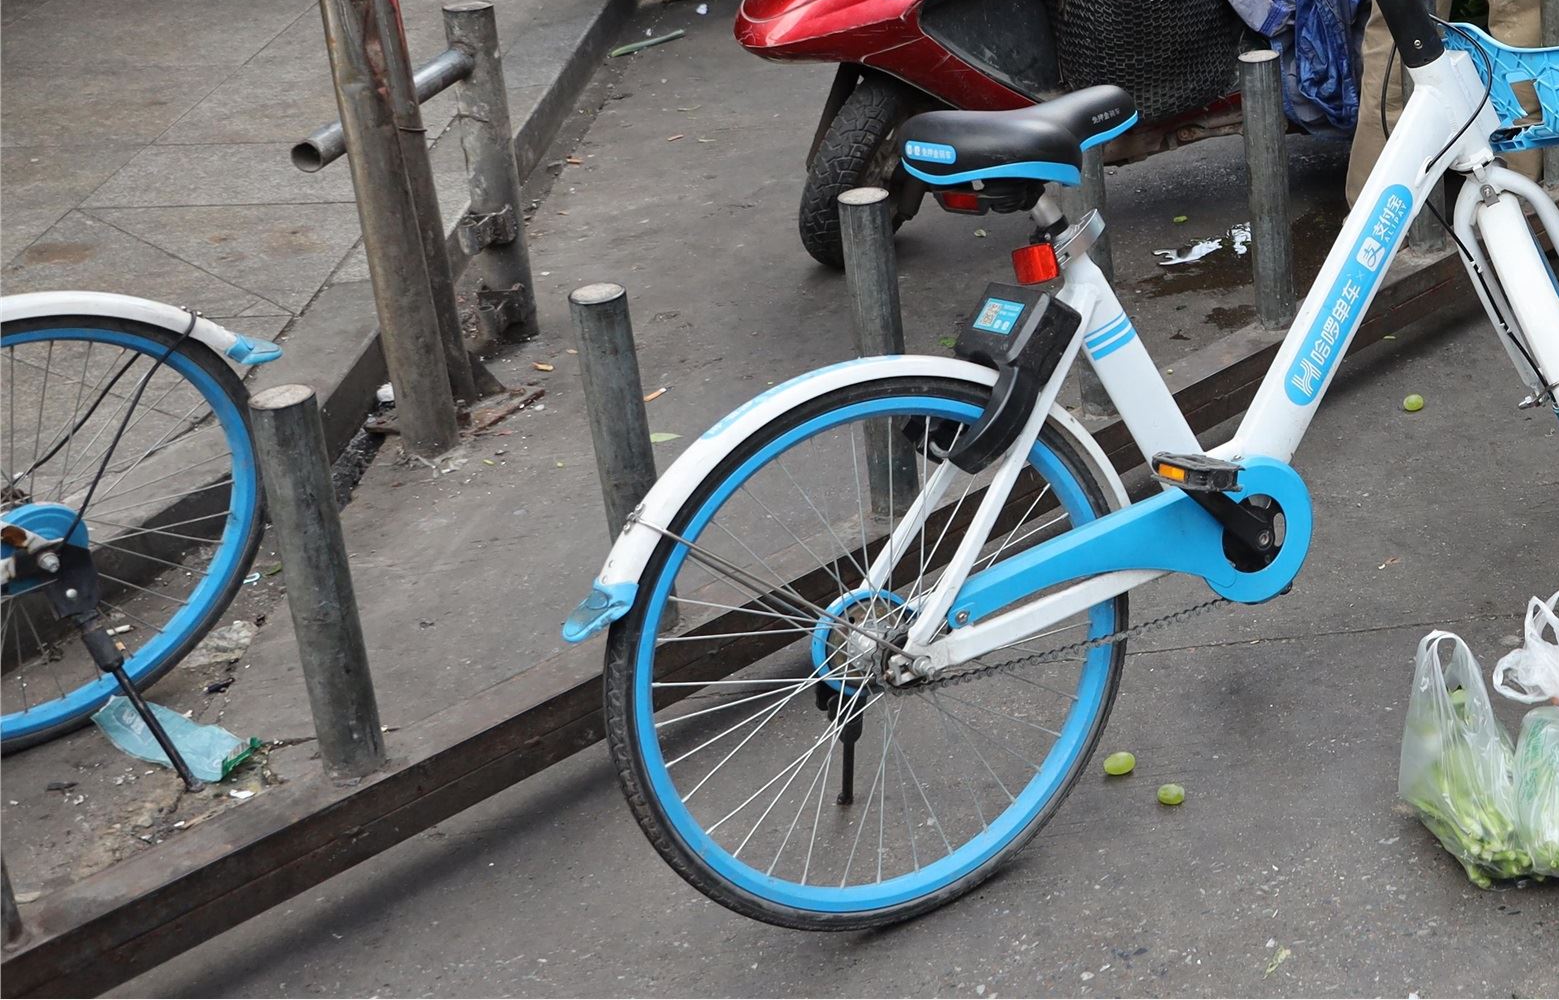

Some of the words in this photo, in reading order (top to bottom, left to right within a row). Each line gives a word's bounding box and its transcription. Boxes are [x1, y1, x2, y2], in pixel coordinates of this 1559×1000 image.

[1372, 194, 1403, 241] 支付宝
[1384, 202, 1407, 243] ALIPAY
